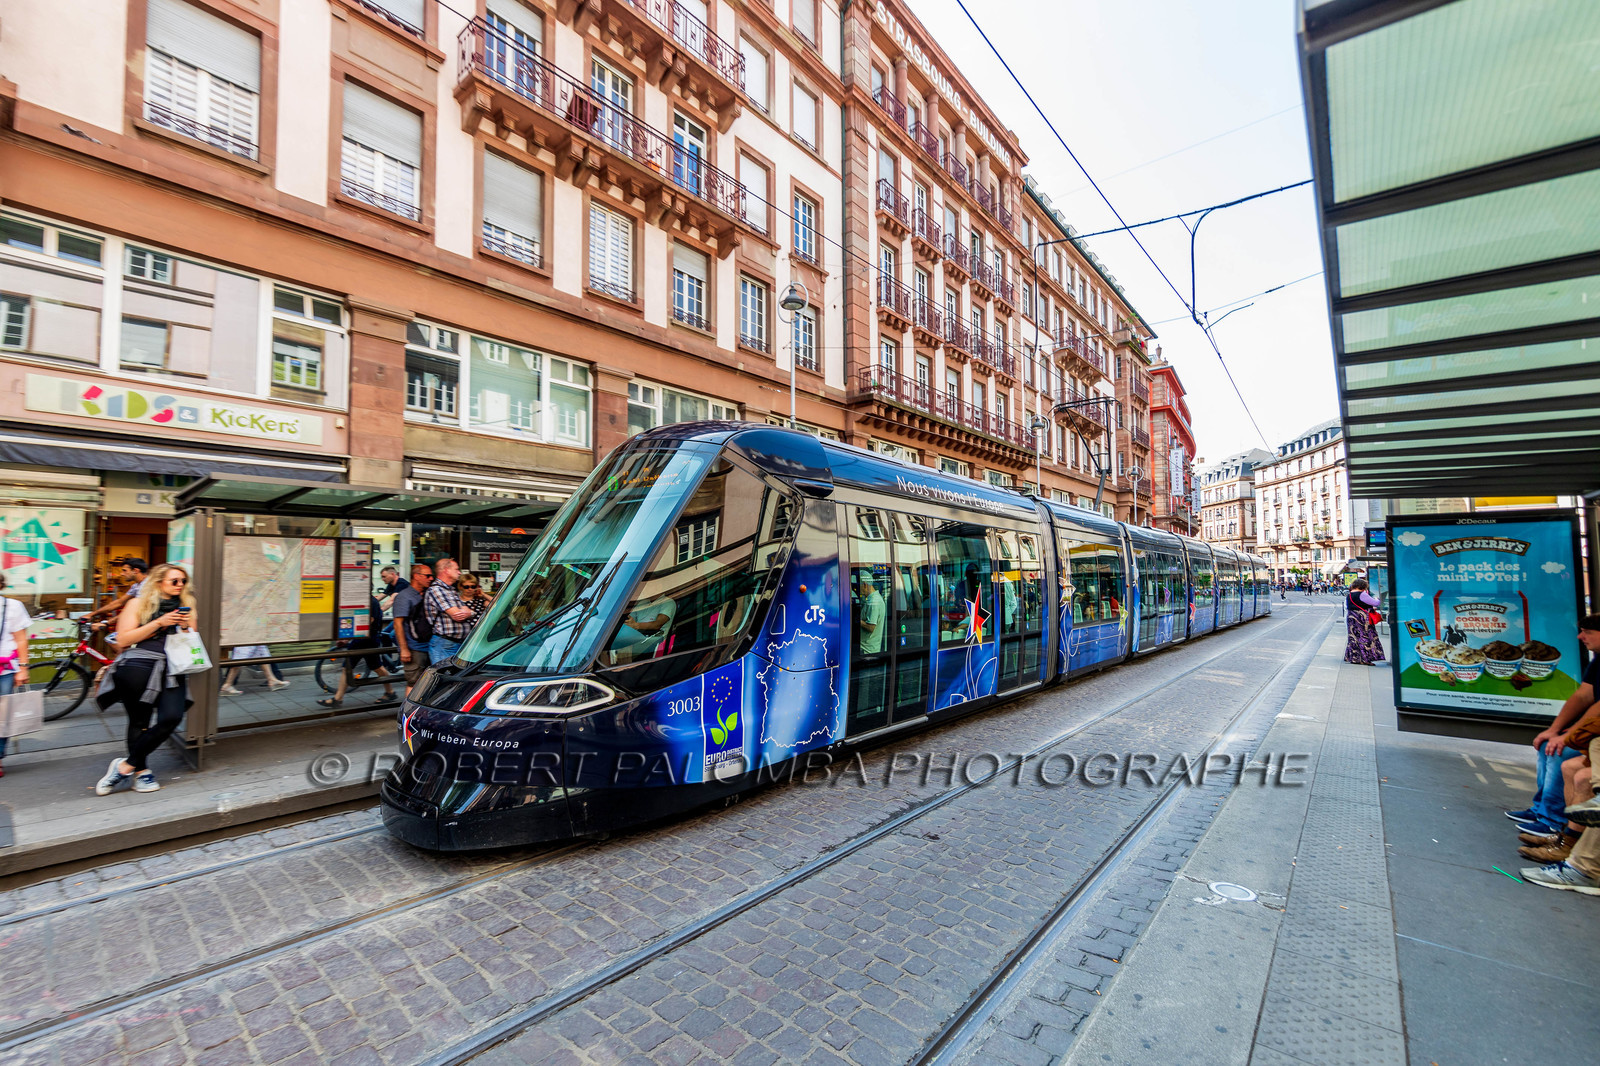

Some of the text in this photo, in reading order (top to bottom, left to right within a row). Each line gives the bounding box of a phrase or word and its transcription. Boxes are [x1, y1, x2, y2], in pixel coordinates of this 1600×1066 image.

[876, 0, 962, 111] STRASBOURG
[969, 108, 1011, 167] BUILDING
[896, 474, 1005, 514] Nous vivons l'Europe
[1437, 572, 1519, 582] mini-POTes
[1440, 561, 1520, 573] Le pack des
[667, 696, 701, 717] 3003
[421, 728, 520, 750] Wir leben Europa
[706, 750, 727, 765] EURO
